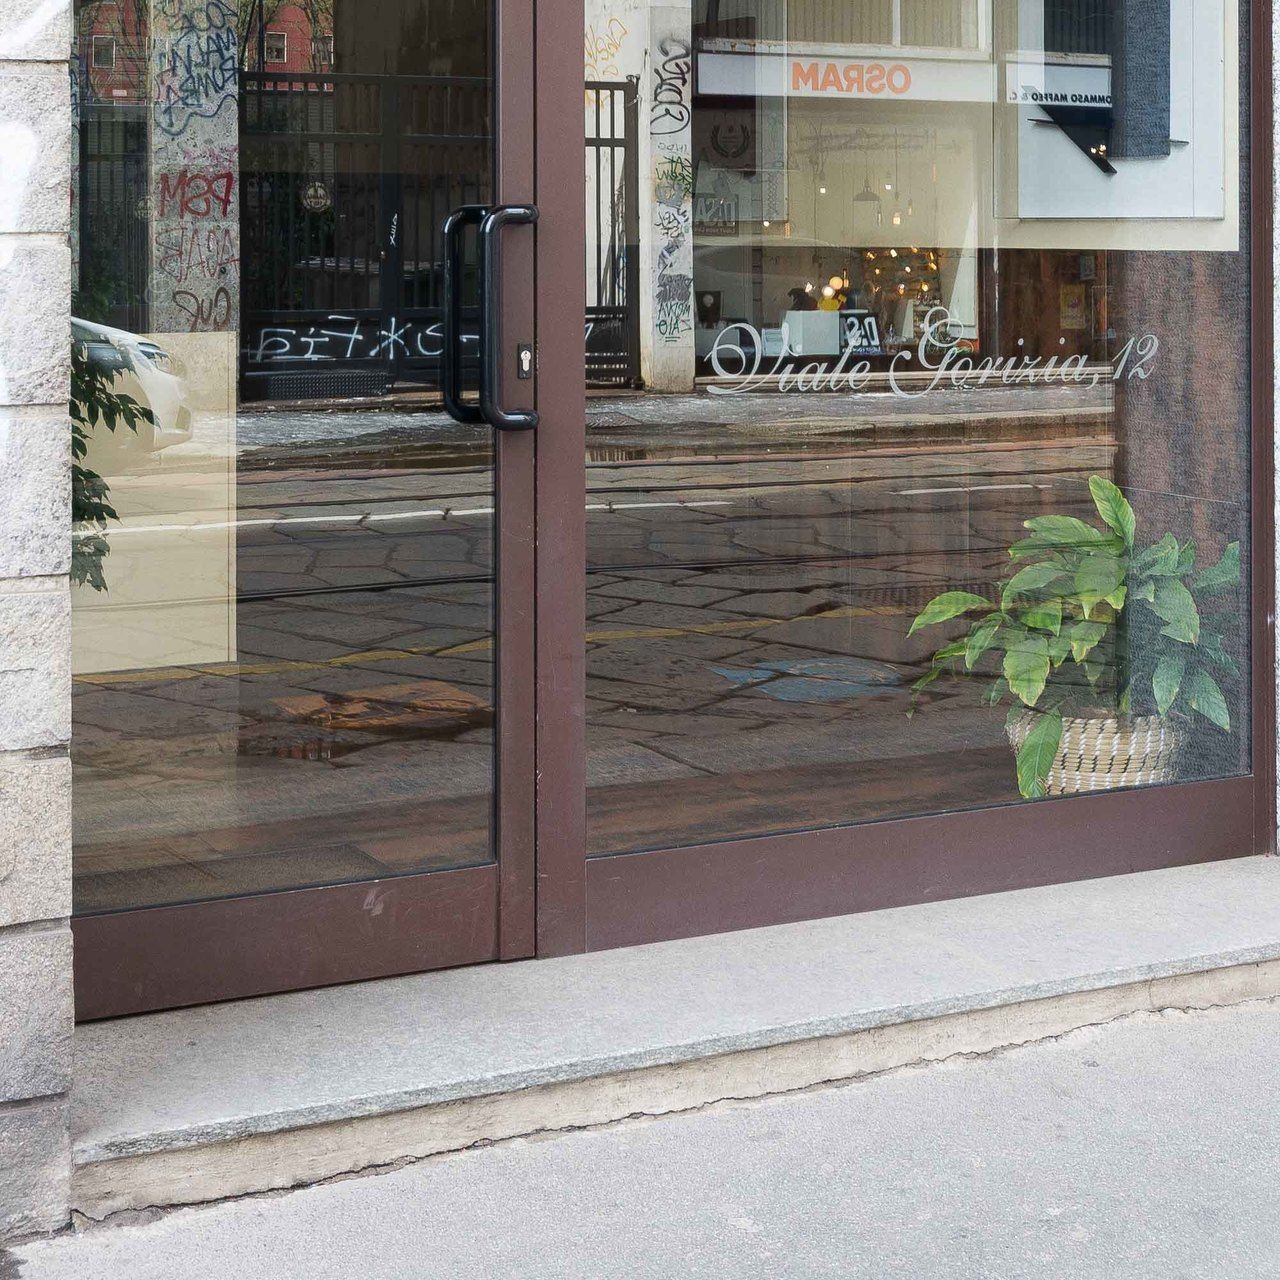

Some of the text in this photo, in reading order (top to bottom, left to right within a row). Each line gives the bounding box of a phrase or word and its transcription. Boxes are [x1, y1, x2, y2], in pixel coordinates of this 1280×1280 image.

[704, 306, 1160, 400] Viale Gorizia, 12
